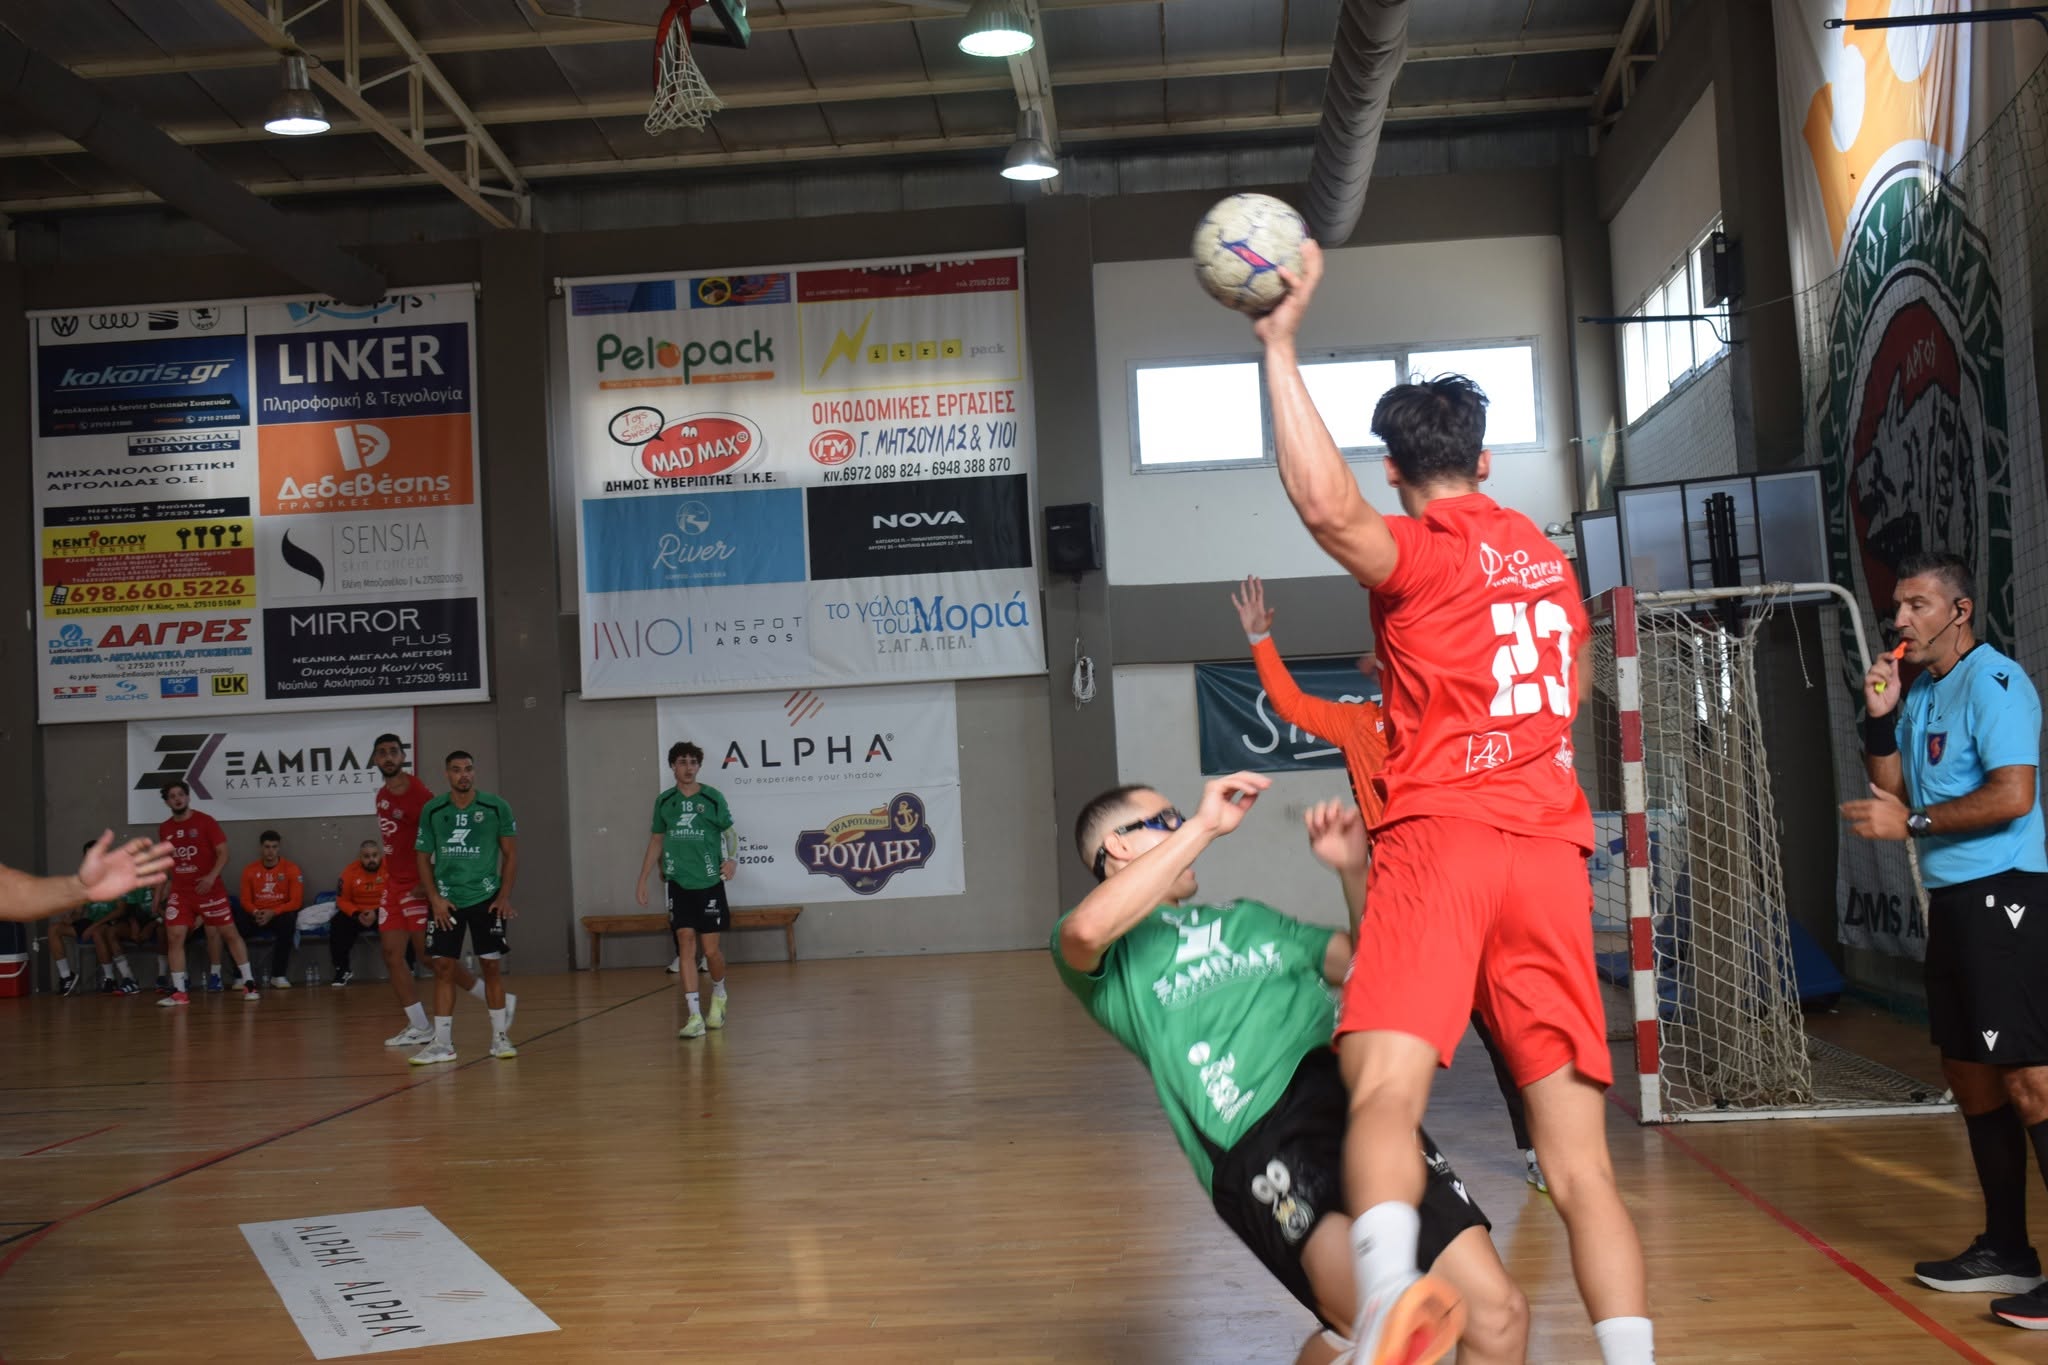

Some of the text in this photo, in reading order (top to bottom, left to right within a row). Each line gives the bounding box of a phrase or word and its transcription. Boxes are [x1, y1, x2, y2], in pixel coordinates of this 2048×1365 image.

[279, 334, 445, 385] LINKER
[596, 329, 774, 385] Pelopack
[970, 343, 1005, 358] pack
[60, 363, 231, 387] kokoris.gr
[263, 386, 464, 414] Πληροφορική & Τεχνολογία
[812, 390, 1016, 425] ΟΙΚΟΔΟΜΙΚΕΣ ΕΡΓΑΣΙΕΣ
[621, 410, 648, 427] Toys
[136, 432, 235, 445] FINANCIAL
[620, 422, 660, 442] Sweets
[859, 421, 1017, 458] Γ. ΜΗΤΣΟΥΛΑΣ & ΥΙΟΙ
[136, 441, 233, 454] SERVICES
[652, 435, 741, 473] MAD MAX
[47, 461, 235, 479] ΜΗΧΑΝΟΛΟΓΙΣΤΙΚΗ
[875, 464, 896, 480] 089
[900, 463, 921, 478] 824
[932, 460, 960, 475] 6948
[964, 458, 985, 474] 388
[989, 457, 1011, 472] 870
[47, 476, 204, 492] ΑΡΓΟΛΙΔΑΣ Ο.Ε.
[277, 473, 450, 501] Δεδεβέσης
[605, 478, 649, 493] ΔΗΜΟΣ
[653, 473, 733, 490] ΚΥΒΕΡΙΩΤΗΣ
[278, 493, 451, 511] ΓΡΑΦΙΚΕΣ ΤΕΧΝΕΣ
[873, 510, 966, 530] NOVA
[52, 529, 147, 549] ΚΕΝΤΙΟΓΛΟΥ
[341, 522, 429, 555] SENSIA
[652, 533, 736, 570] River
[70, 578, 245, 603] 698.660.5226
[825, 595, 910, 623] το γάλα
[909, 590, 1030, 638] Μοριά
[290, 608, 421, 637] MIRROR
[704, 616, 803, 633] INSPOT
[872, 617, 910, 635] του
[49, 638, 93, 649] DGR
[97, 618, 252, 649] ΔΑΓΡΕΣ
[392, 633, 452, 646] PLUS
[716, 633, 794, 646] ARGOS
[127, 660, 185, 670] 27520 91117
[292, 649, 452, 665] ΝΕΑΝΙΚΑ ΜΕΓΑΛΑ ΜΕΓΕΘΗ
[1490, 600, 1573, 718] 23
[277, 680, 318, 691] Ναύπλιο
[378, 677, 390, 686] 71
[438, 672, 468, 682] 99111
[301, 665, 377, 678] Οικονόμου
[105, 693, 149, 702] SACHS
[721, 733, 894, 770] ALPHA
[734, 771, 883, 785] Our experience your shadow
[681, 800, 693, 812] 18
[456, 813, 468, 827] 15
[739, 855, 775, 865] 52006
[812, 839, 921, 871] ΡΟΥΛΗΣ
[293, 1225, 366, 1268] ALPHA
[334, 1281, 423, 1337] ALPHA
